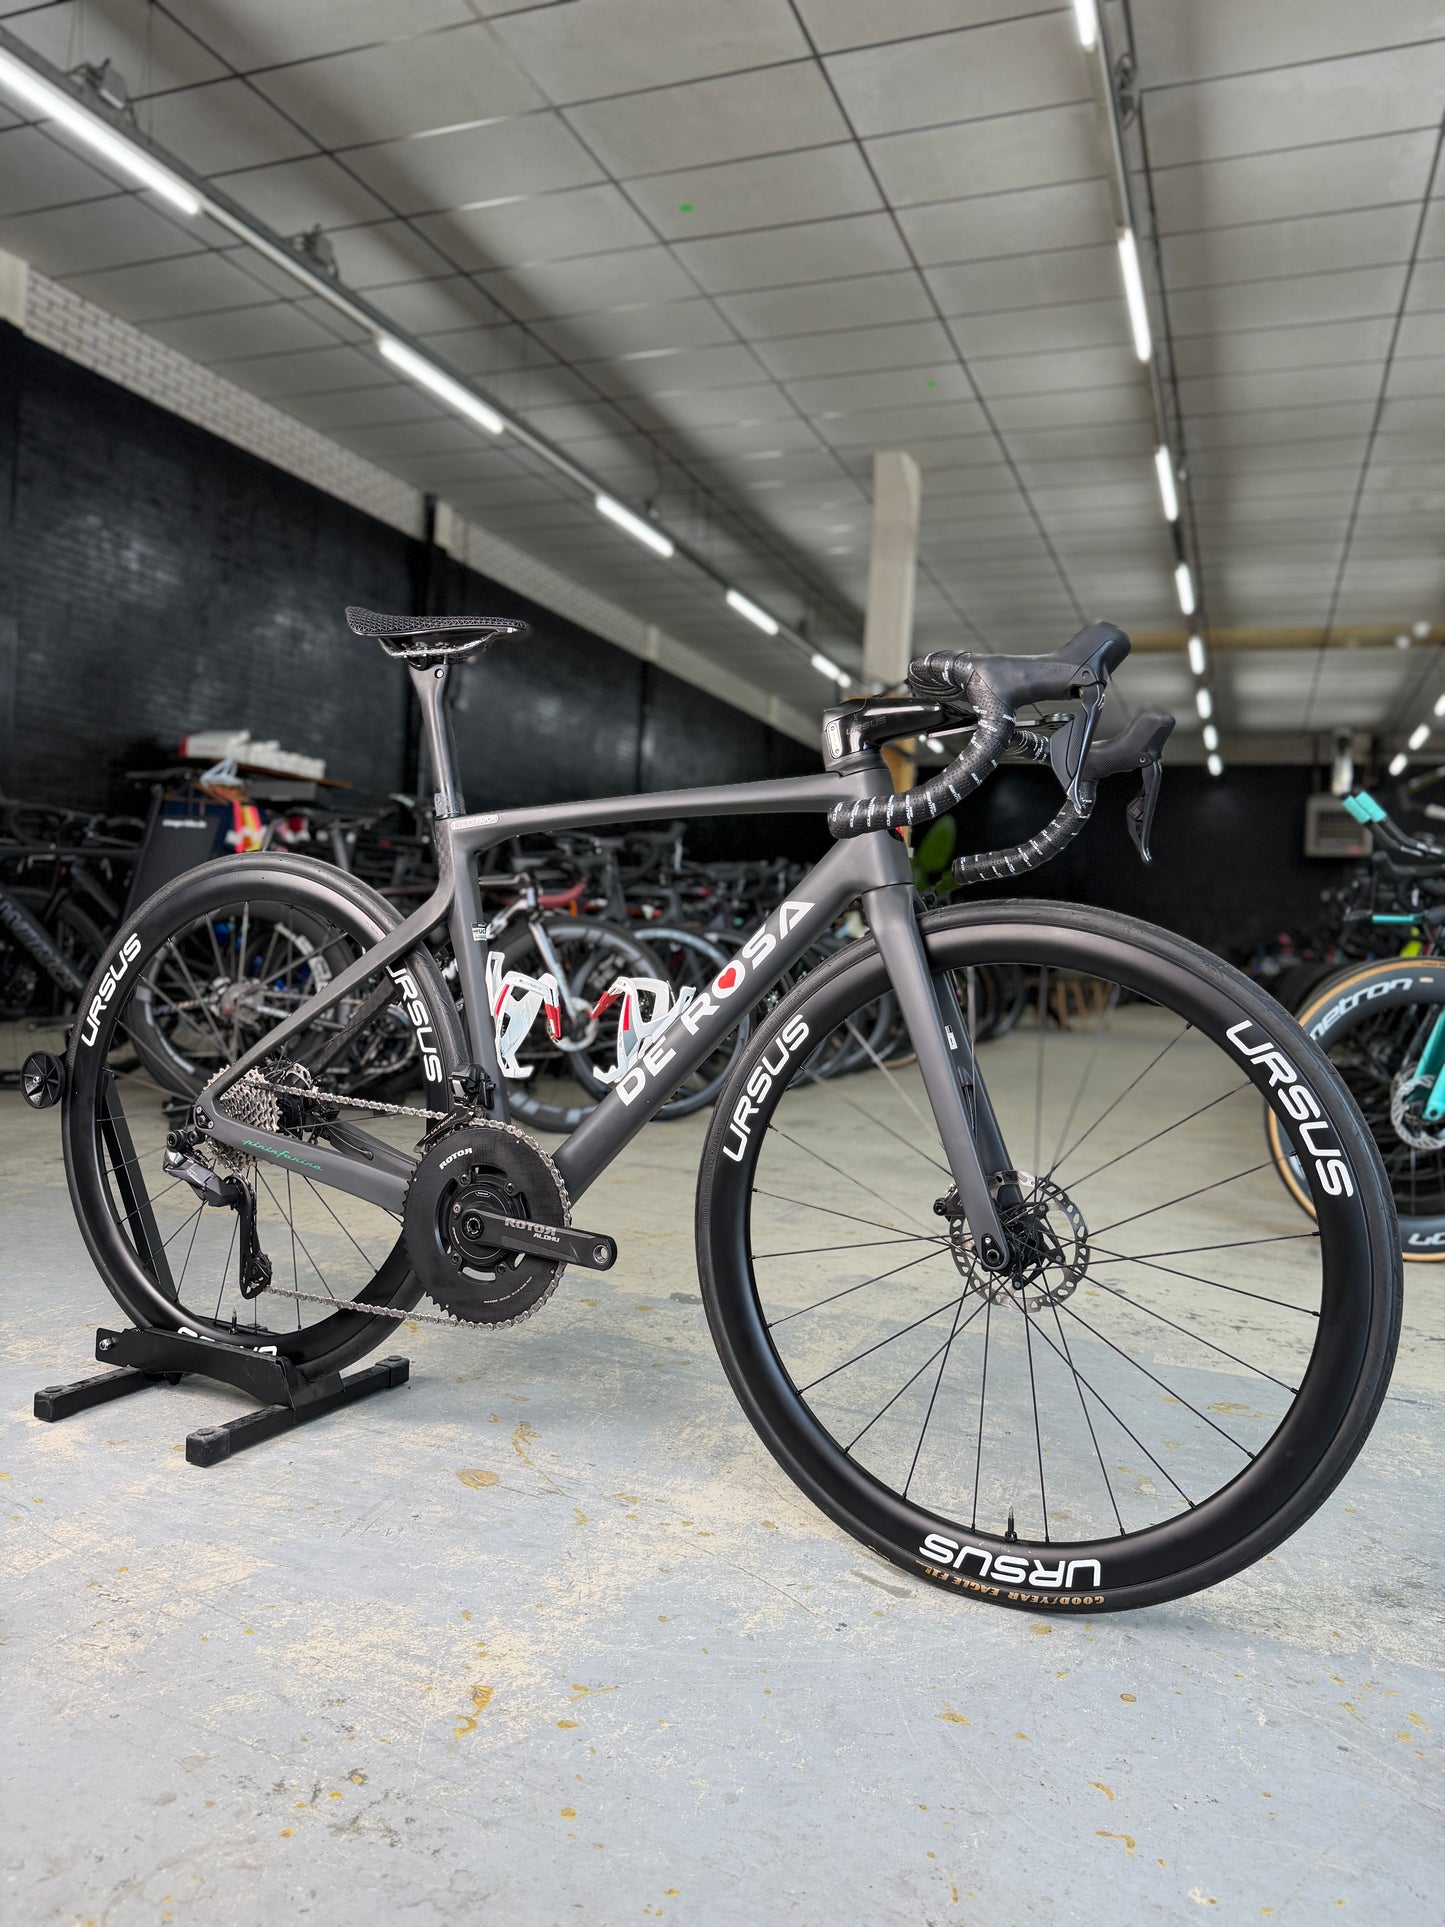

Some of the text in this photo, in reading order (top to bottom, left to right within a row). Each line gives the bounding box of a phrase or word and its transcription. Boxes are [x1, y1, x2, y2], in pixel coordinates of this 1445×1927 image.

[81, 932, 142, 1047] URSUS
[616, 900, 816, 1107] DE ROSA
[722, 1013, 810, 1163] URSUS
[1225, 1019, 1354, 1198] URSUS
[242, 1139, 324, 1171] pininfarina
[918, 1533, 1102, 1588] URSUS
[951, 1577, 1001, 1597] EAGLE
